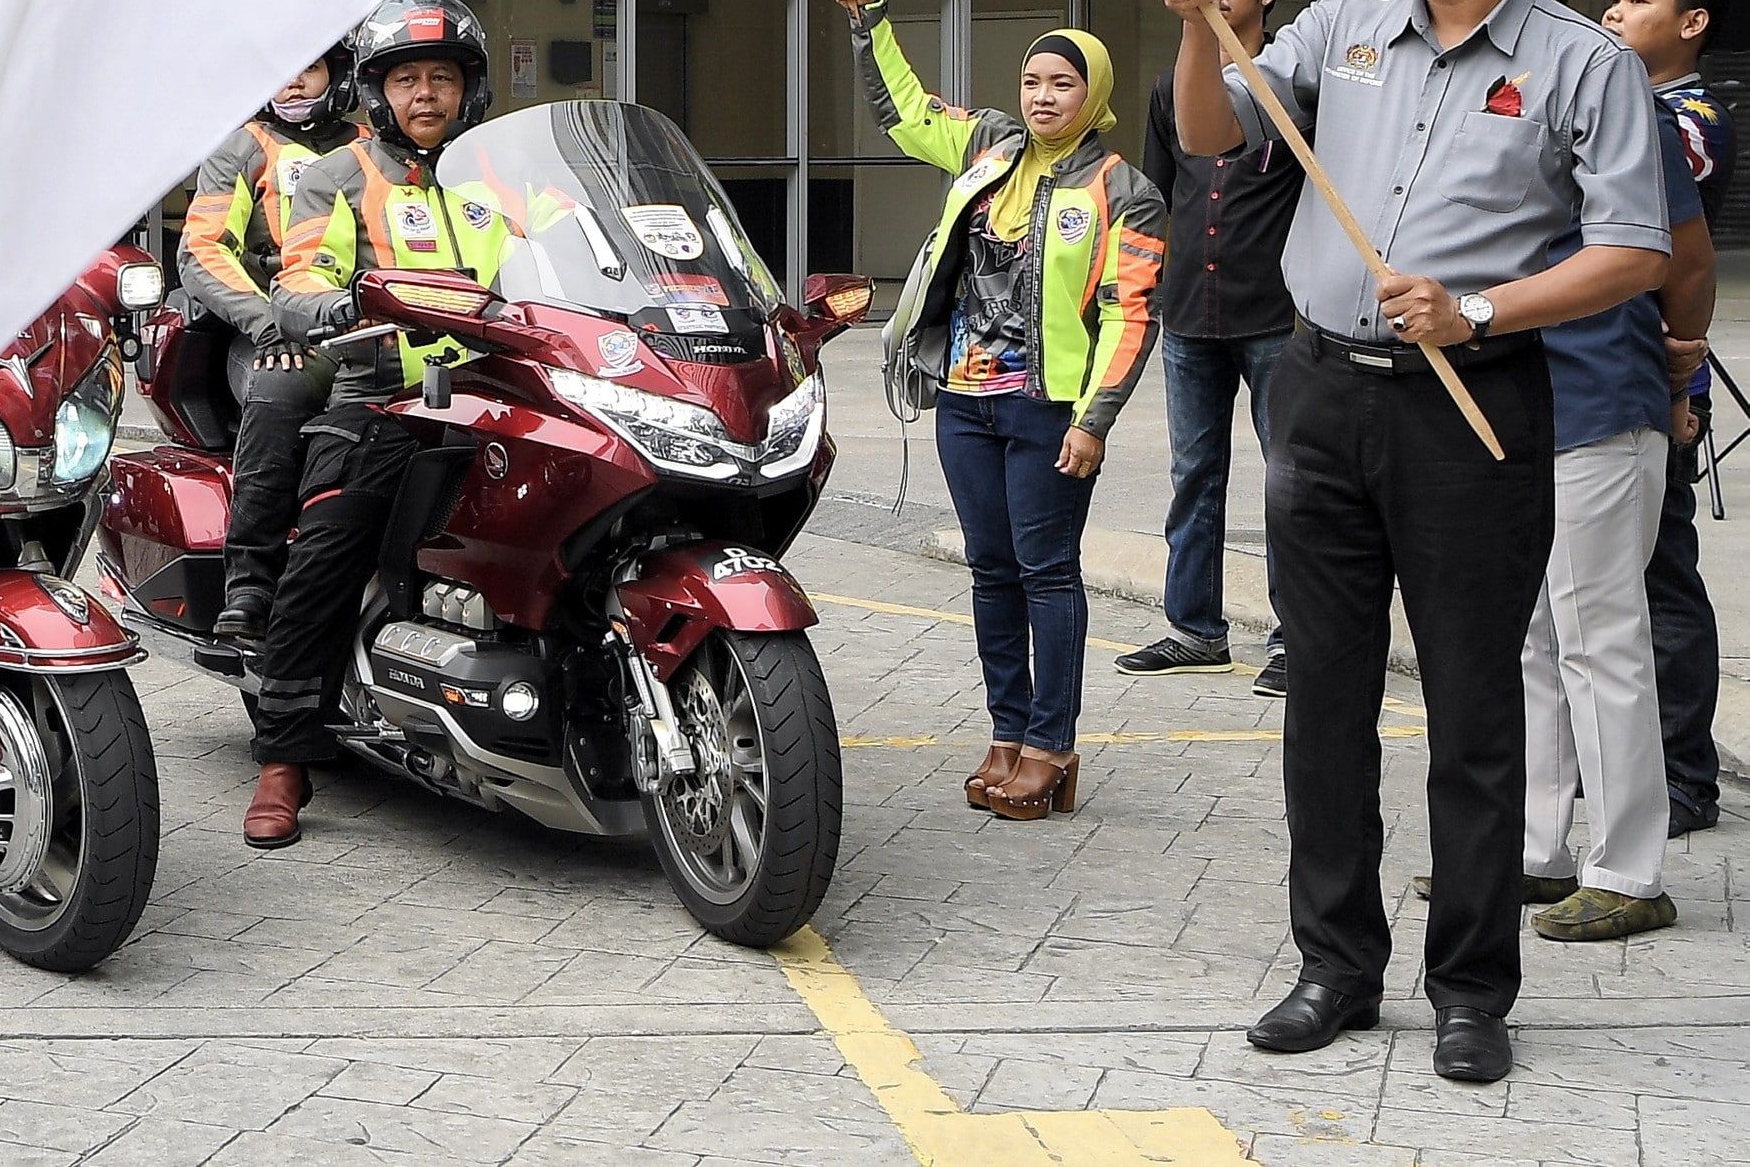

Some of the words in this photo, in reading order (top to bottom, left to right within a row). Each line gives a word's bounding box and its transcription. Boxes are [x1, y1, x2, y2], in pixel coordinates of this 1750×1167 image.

[967, 298, 1023, 332] BIKERS
[722, 547, 748, 558] D
[713, 556, 783, 580] 4702
[388, 668, 426, 690] HONDA
